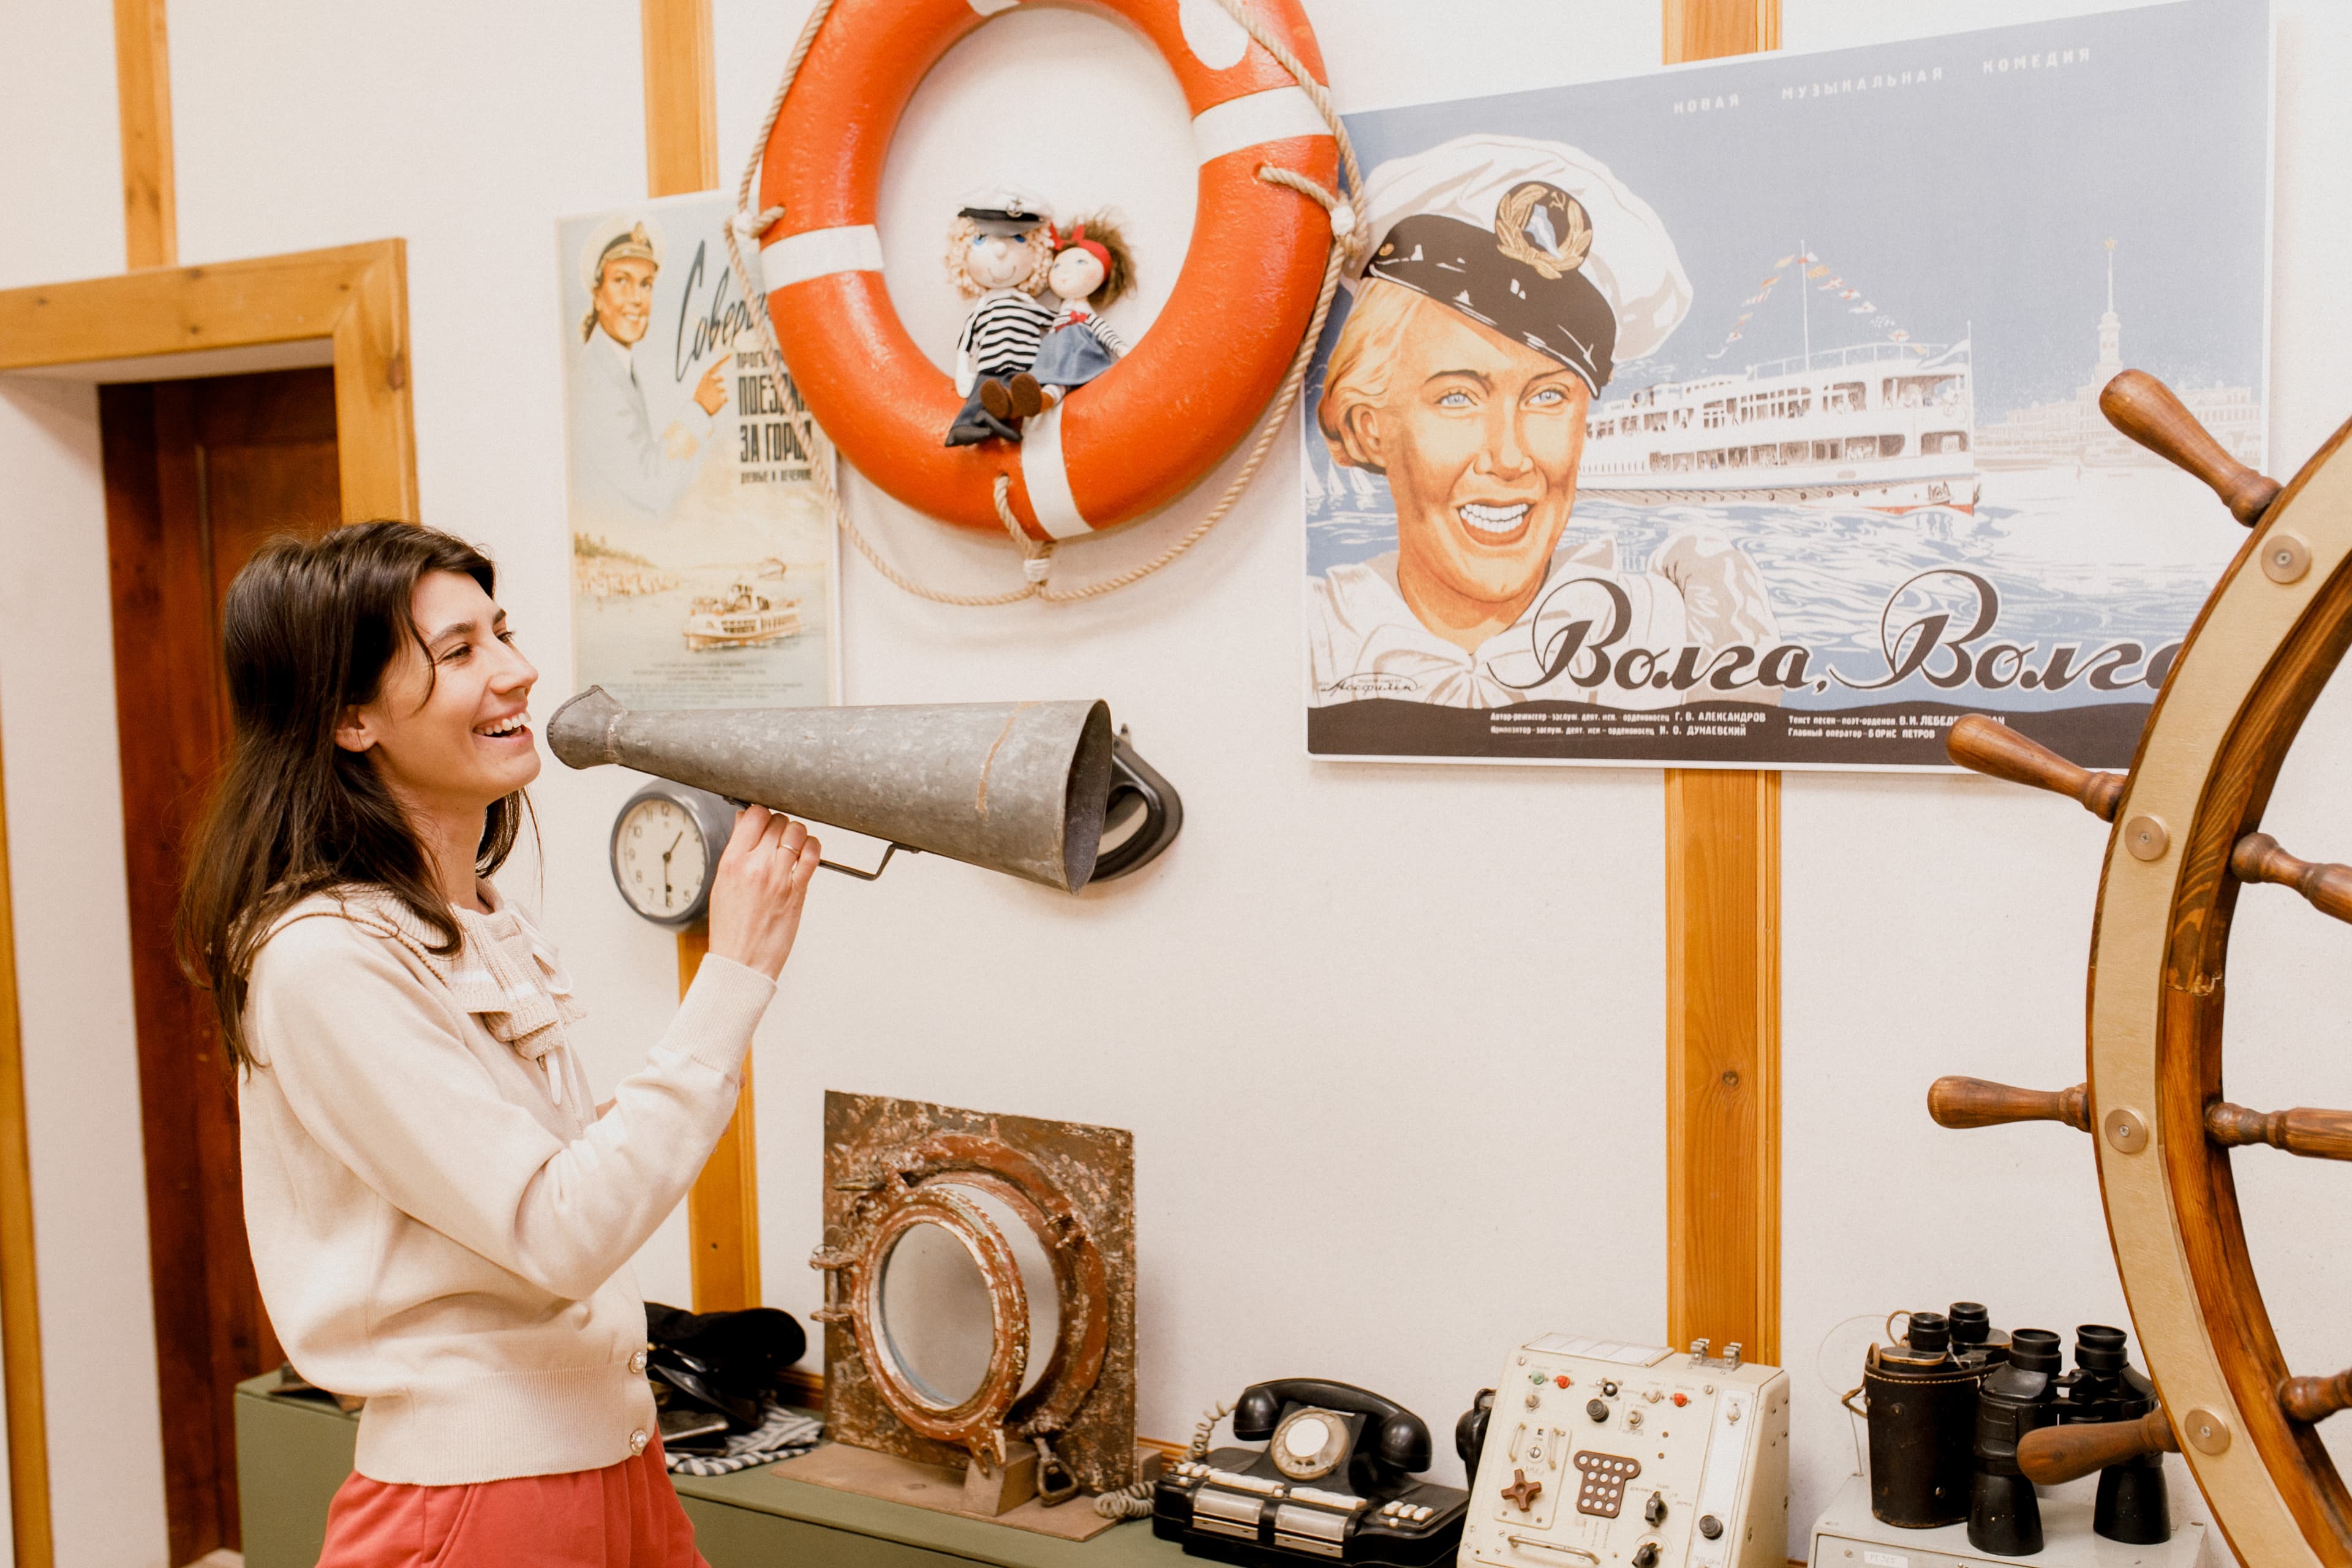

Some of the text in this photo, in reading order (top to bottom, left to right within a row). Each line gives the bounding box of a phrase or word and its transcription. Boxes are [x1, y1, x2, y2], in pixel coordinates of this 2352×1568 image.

[1673, 48, 2090, 114] НОВАЯ МУЗЫКАЛЬНАЯ КОМЕДИЯ
[676, 239, 769, 382] Совер
[739, 374, 805, 415] ПОЕЗ
[741, 424, 760, 462] ЗА
[1487, 578, 1827, 693] Волга,
[1659, 725, 1668, 734] И.
[1672, 725, 1681, 735] О.
[1687, 723, 1746, 736] ДУНАЕВСКИЙ
[1675, 711, 1683, 722] Г.
[1685, 711, 1694, 722] В.
[1698, 711, 1766, 723] АЛЕКСАНДРОВ
[1902, 729, 1936, 739] ПЕТРОВ
